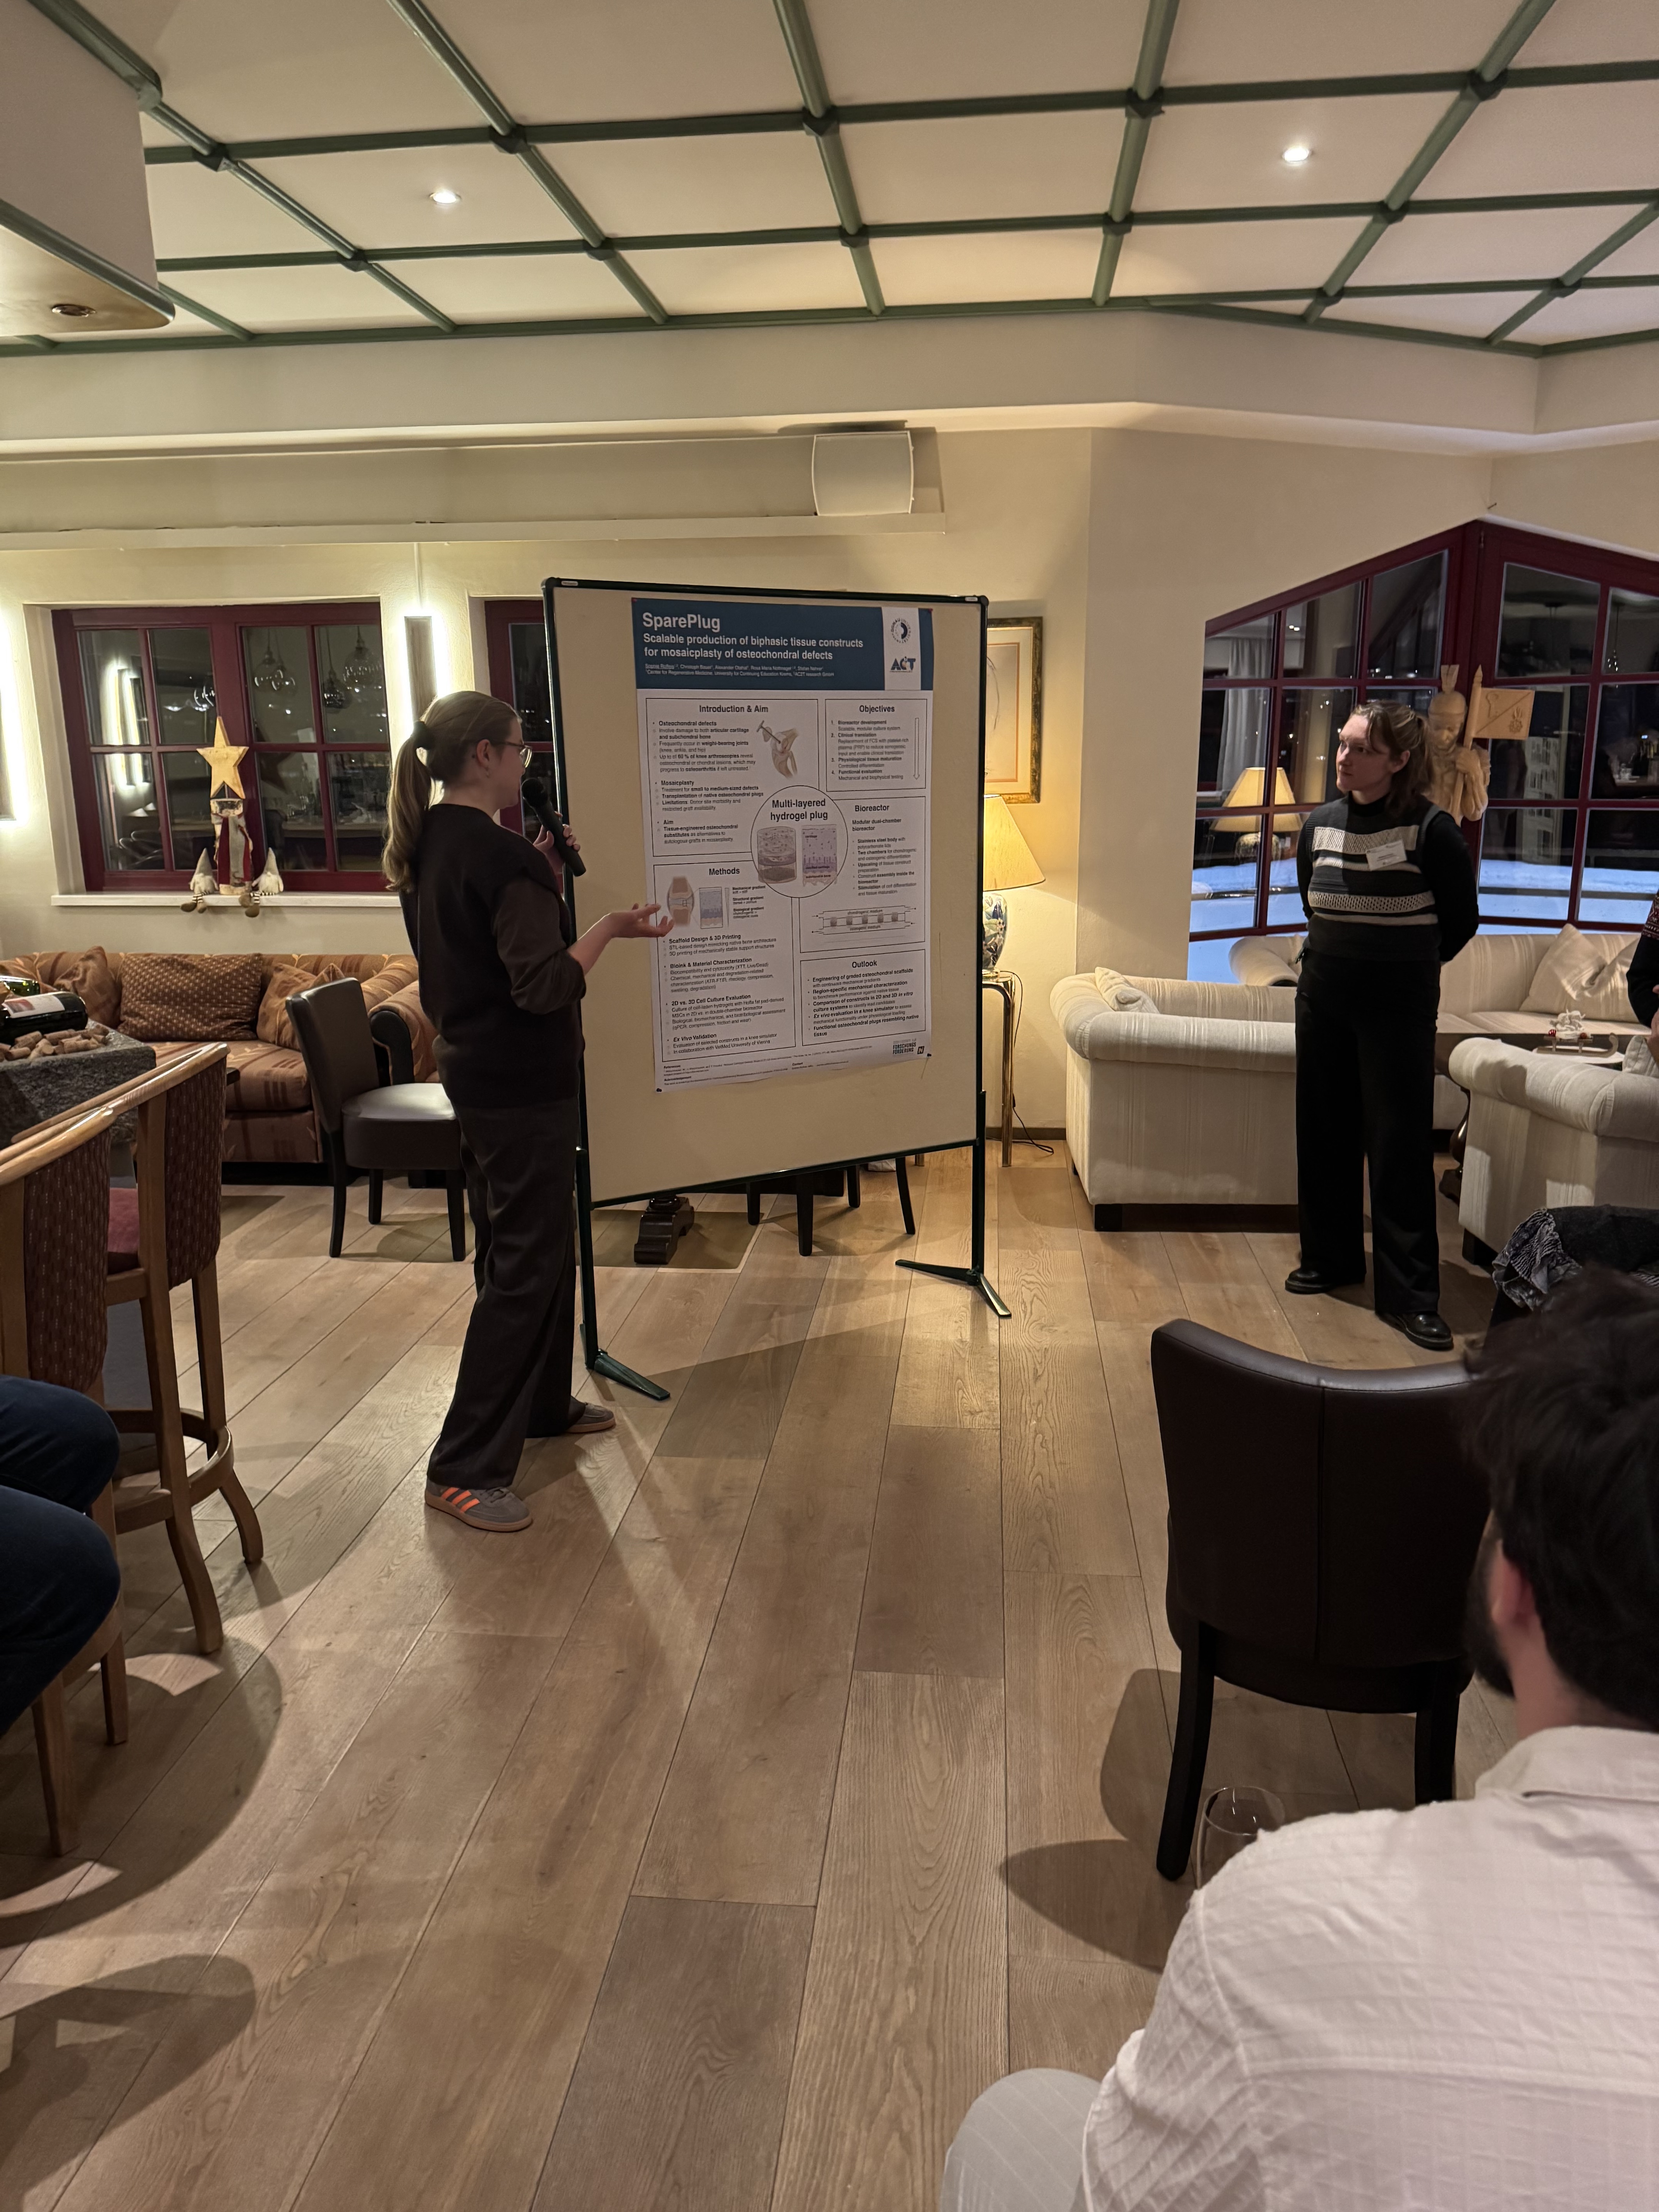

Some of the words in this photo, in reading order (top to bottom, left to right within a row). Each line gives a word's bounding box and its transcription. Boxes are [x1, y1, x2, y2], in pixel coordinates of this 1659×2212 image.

[643, 612, 720, 632] SparePlug
[644, 633, 684, 644] Scalable
[687, 635, 736, 645] production
[740, 636, 748, 645] of
[751, 636, 788, 647] biphasic
[790, 637, 816, 646] tissue
[819, 639, 863, 647] constructs
[644, 647, 658, 656] for
[661, 647, 721, 659] mosaicplasty
[725, 649, 734, 658] of
[737, 650, 799, 659] osteochondral
[802, 650, 833, 659] defects
[859, 705, 895, 714] Objectives
[772, 799, 826, 809] Multi-layered
[771, 811, 807, 822] hydrogel
[810, 811, 828, 821] plug
[852, 960, 877, 968] Outlook
